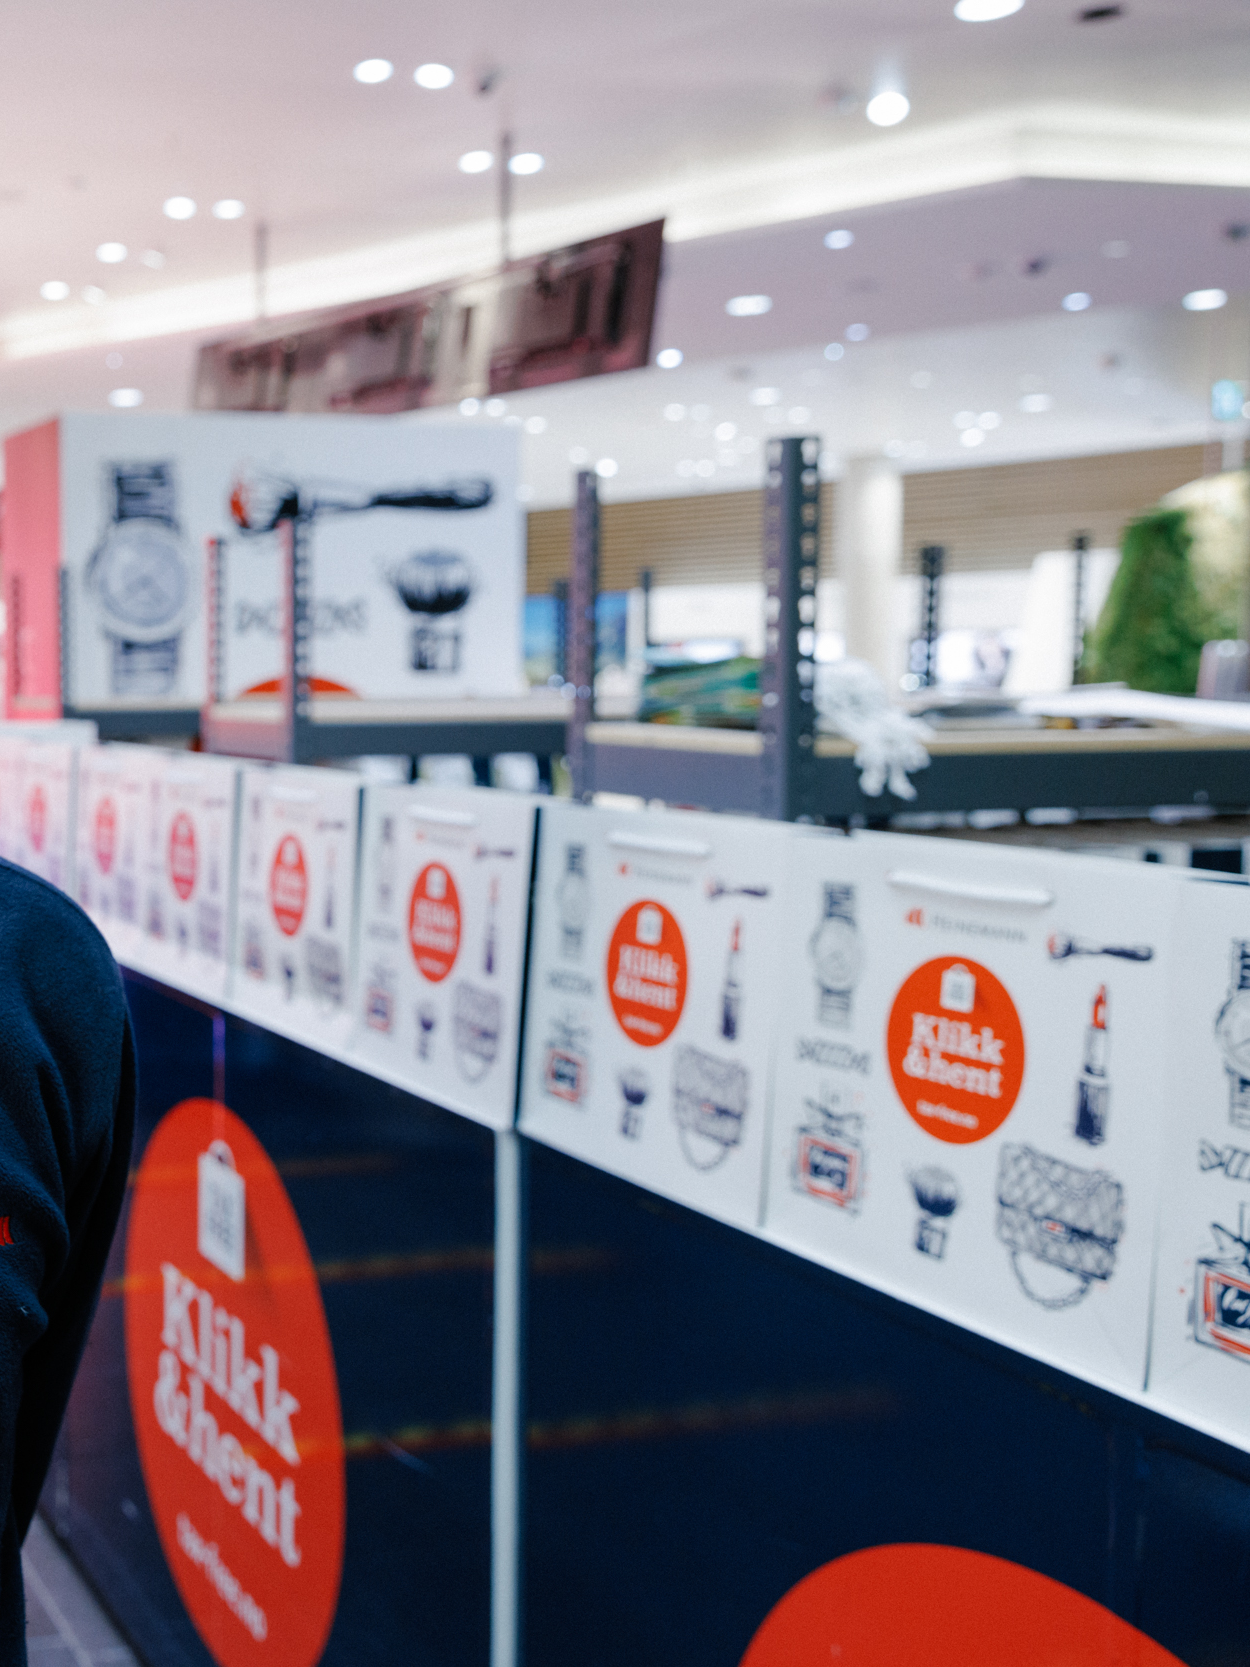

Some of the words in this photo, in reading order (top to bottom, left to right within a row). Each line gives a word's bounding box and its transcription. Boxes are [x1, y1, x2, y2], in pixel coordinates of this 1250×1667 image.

[902, 1043, 1004, 1099] &hent
[910, 1011, 1006, 1066] Klikk
[160, 1261, 302, 1467] Klikk
[153, 1347, 302, 1568] &hent
